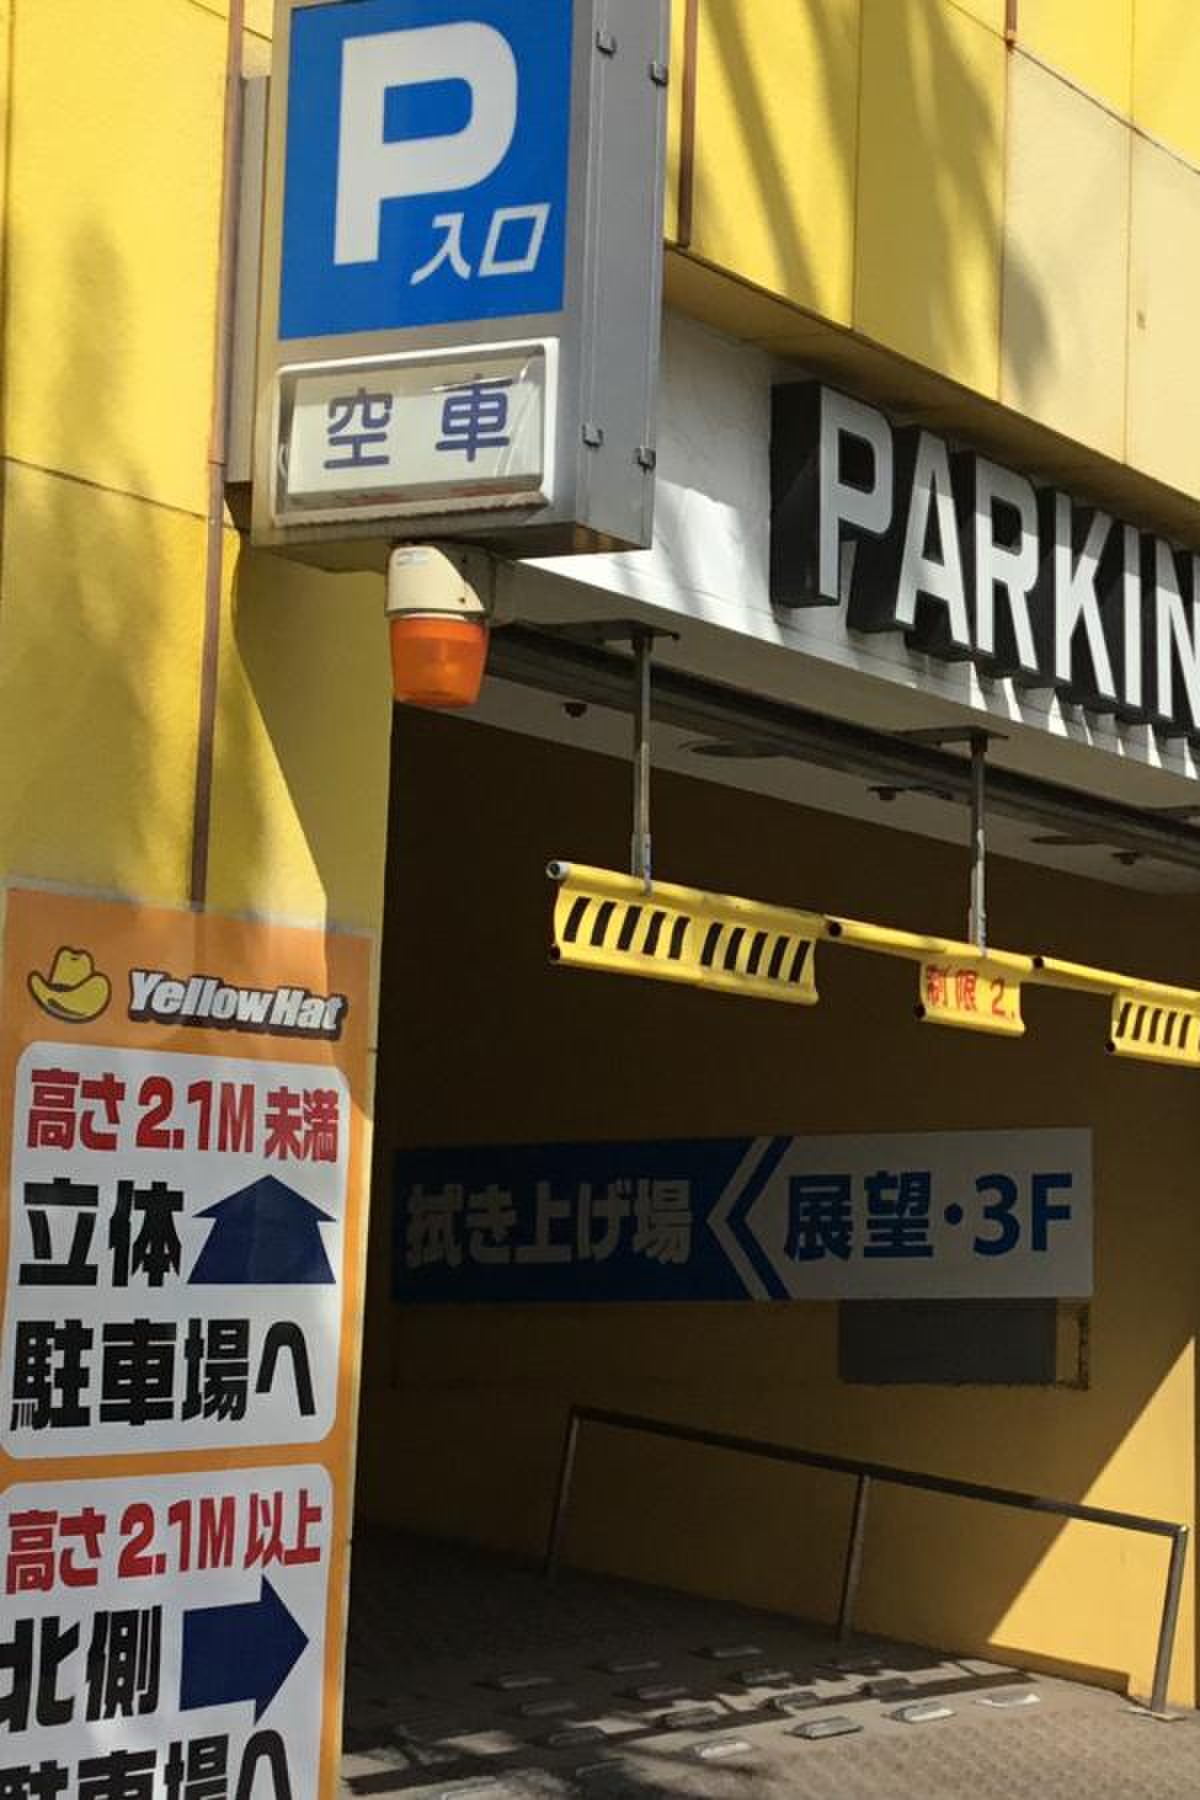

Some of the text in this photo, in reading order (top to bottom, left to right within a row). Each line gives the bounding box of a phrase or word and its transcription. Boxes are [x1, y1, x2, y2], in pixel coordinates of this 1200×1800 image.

[334, 20, 518, 266] P
[410, 203, 550, 285] 入口
[323, 373, 513, 470] 空車
[18, 1177, 184, 1287] 立体
[405, 1177, 691, 1268] 拭き上げ場
[10, 1319, 316, 1431] 駐車場へ
[0, 1605, 163, 1732] 北側
